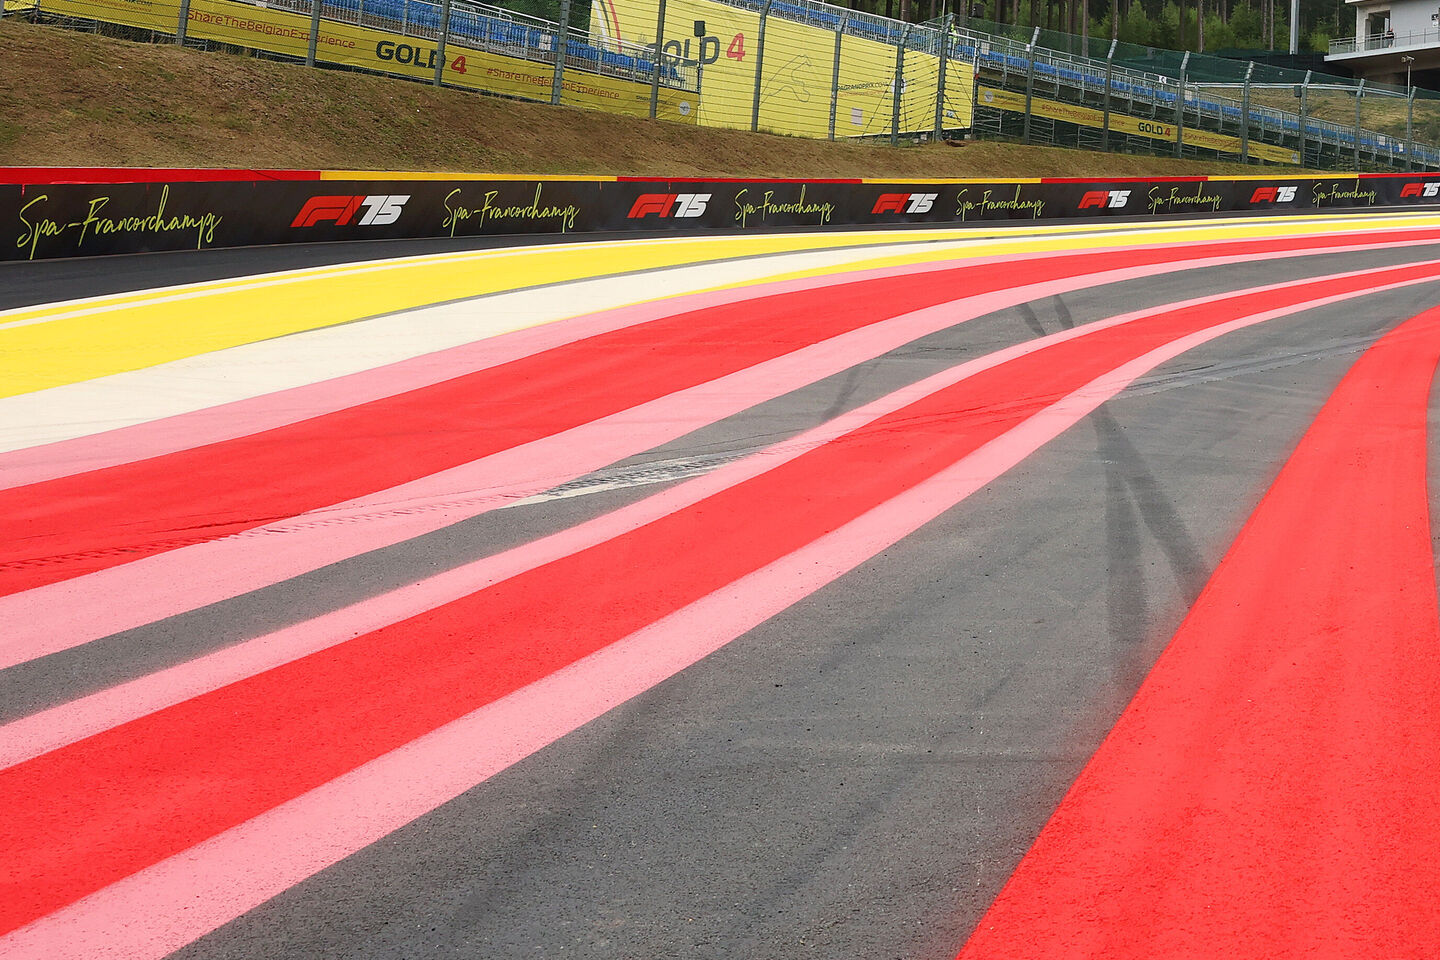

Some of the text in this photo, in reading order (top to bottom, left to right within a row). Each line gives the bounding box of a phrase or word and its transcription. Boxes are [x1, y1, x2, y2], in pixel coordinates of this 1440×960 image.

[376, 41, 467, 74] GOLD 4
[726, 33, 746, 62] 4
[1138, 122, 1171, 137] GOLD 4
[17, 184, 223, 260] Spa-Francorchamps
